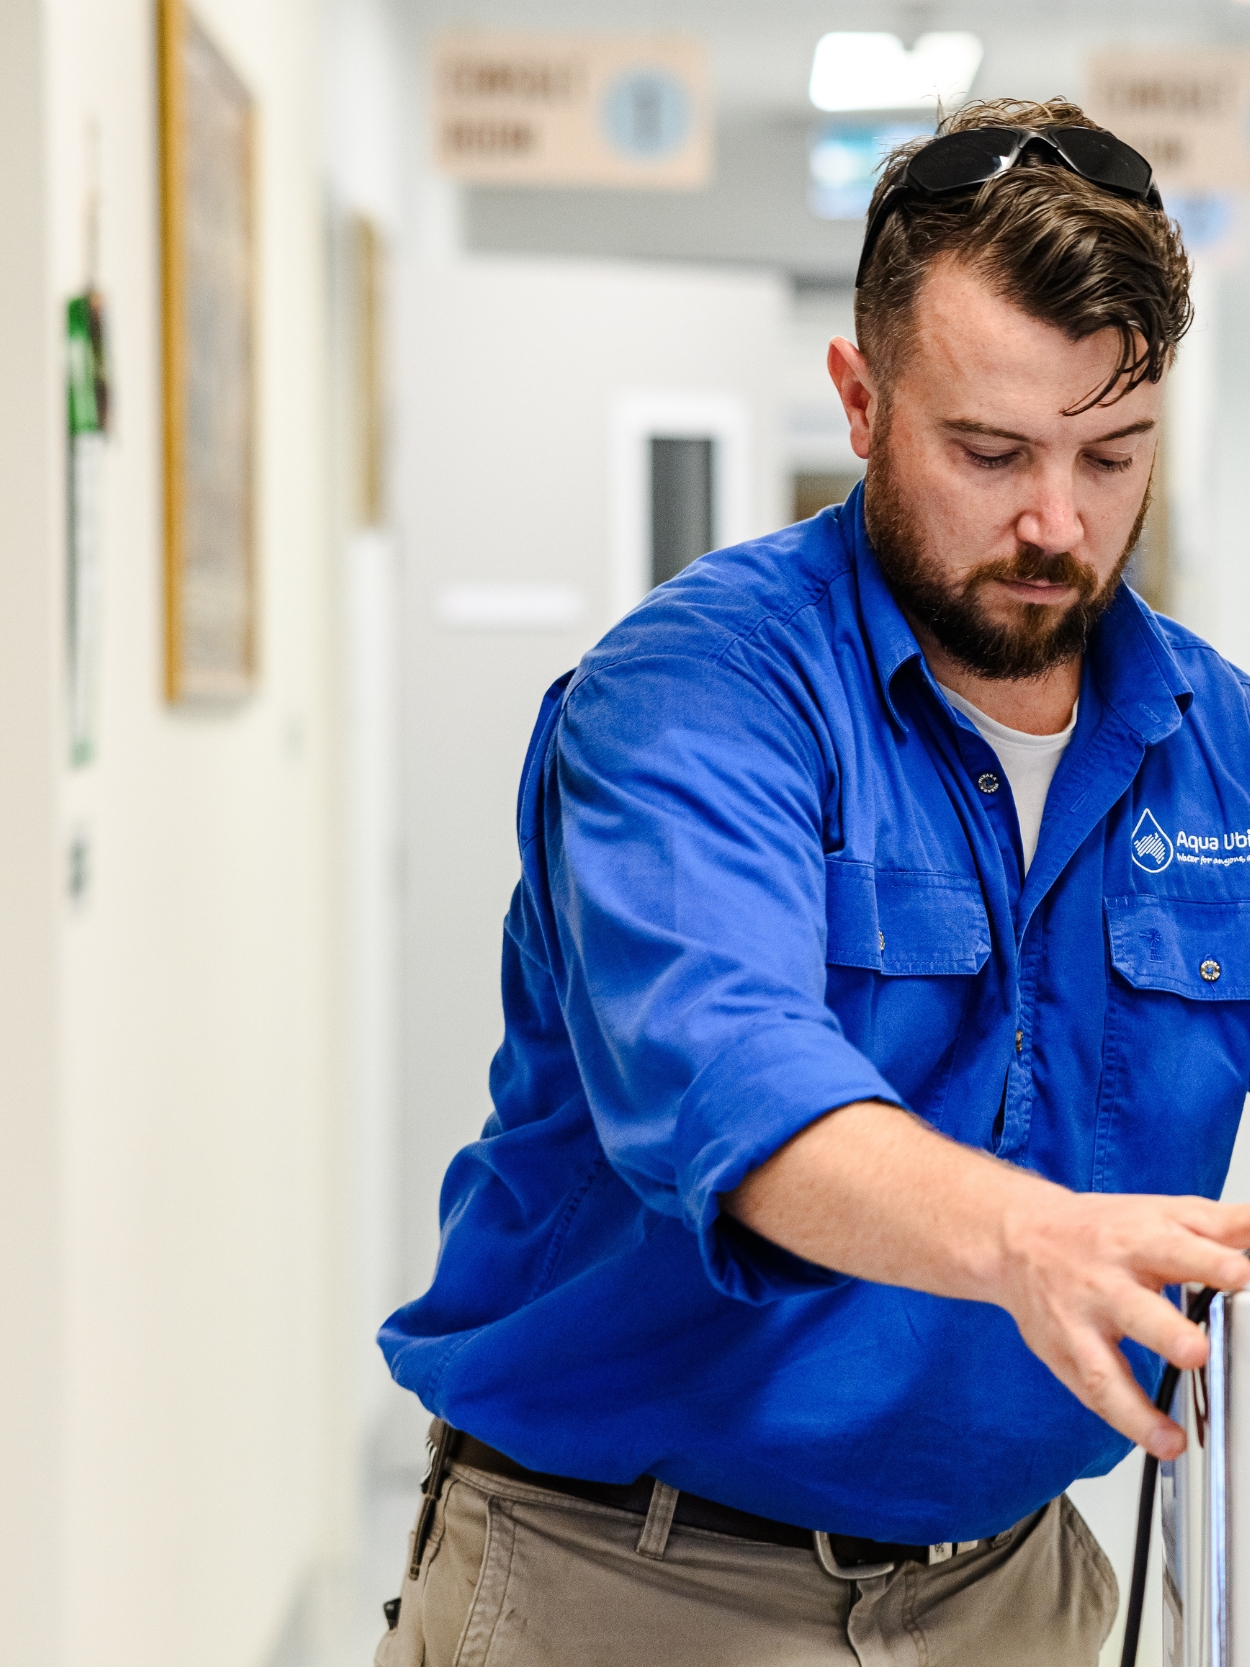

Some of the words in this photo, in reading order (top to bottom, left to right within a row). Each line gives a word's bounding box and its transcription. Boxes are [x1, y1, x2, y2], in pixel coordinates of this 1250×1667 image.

[1176, 830, 1219, 853] Aqua
[1176, 852, 1199, 864] Water
[1200, 854, 1213, 866] for
